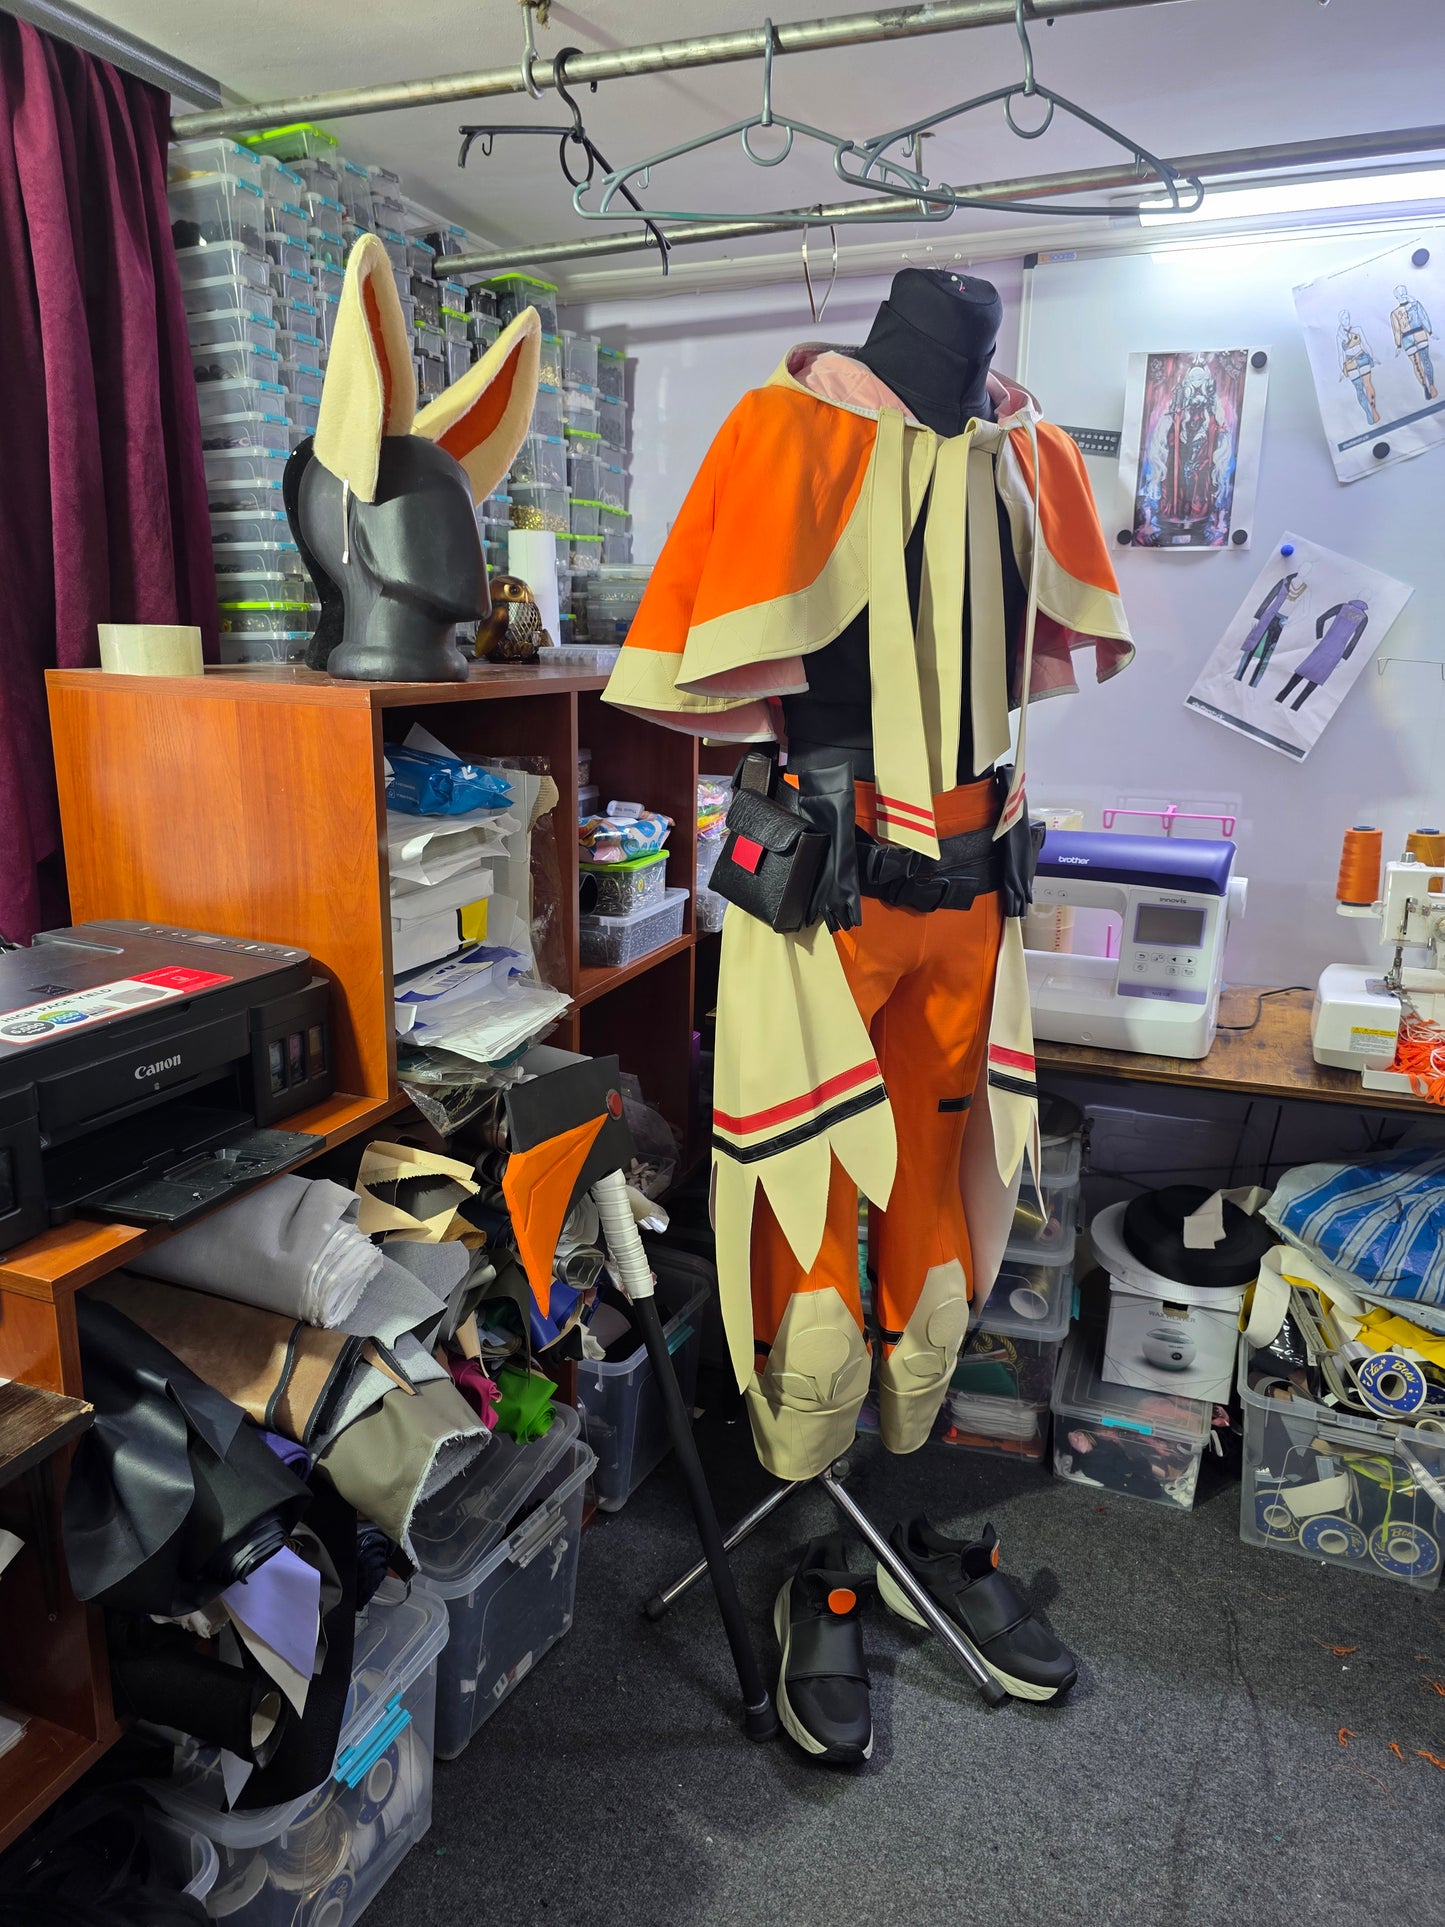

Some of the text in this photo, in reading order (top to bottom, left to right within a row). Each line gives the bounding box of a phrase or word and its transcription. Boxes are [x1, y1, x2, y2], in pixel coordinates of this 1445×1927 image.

[1058, 855, 1090, 865] brother
[1, 1010, 37, 1024] HIGH
[39, 1000, 74, 1012] PAGE
[75, 988, 112, 1001] YIELD
[134, 1053, 182, 1080] Canon
[1364, 1362, 1384, 1387] Star
